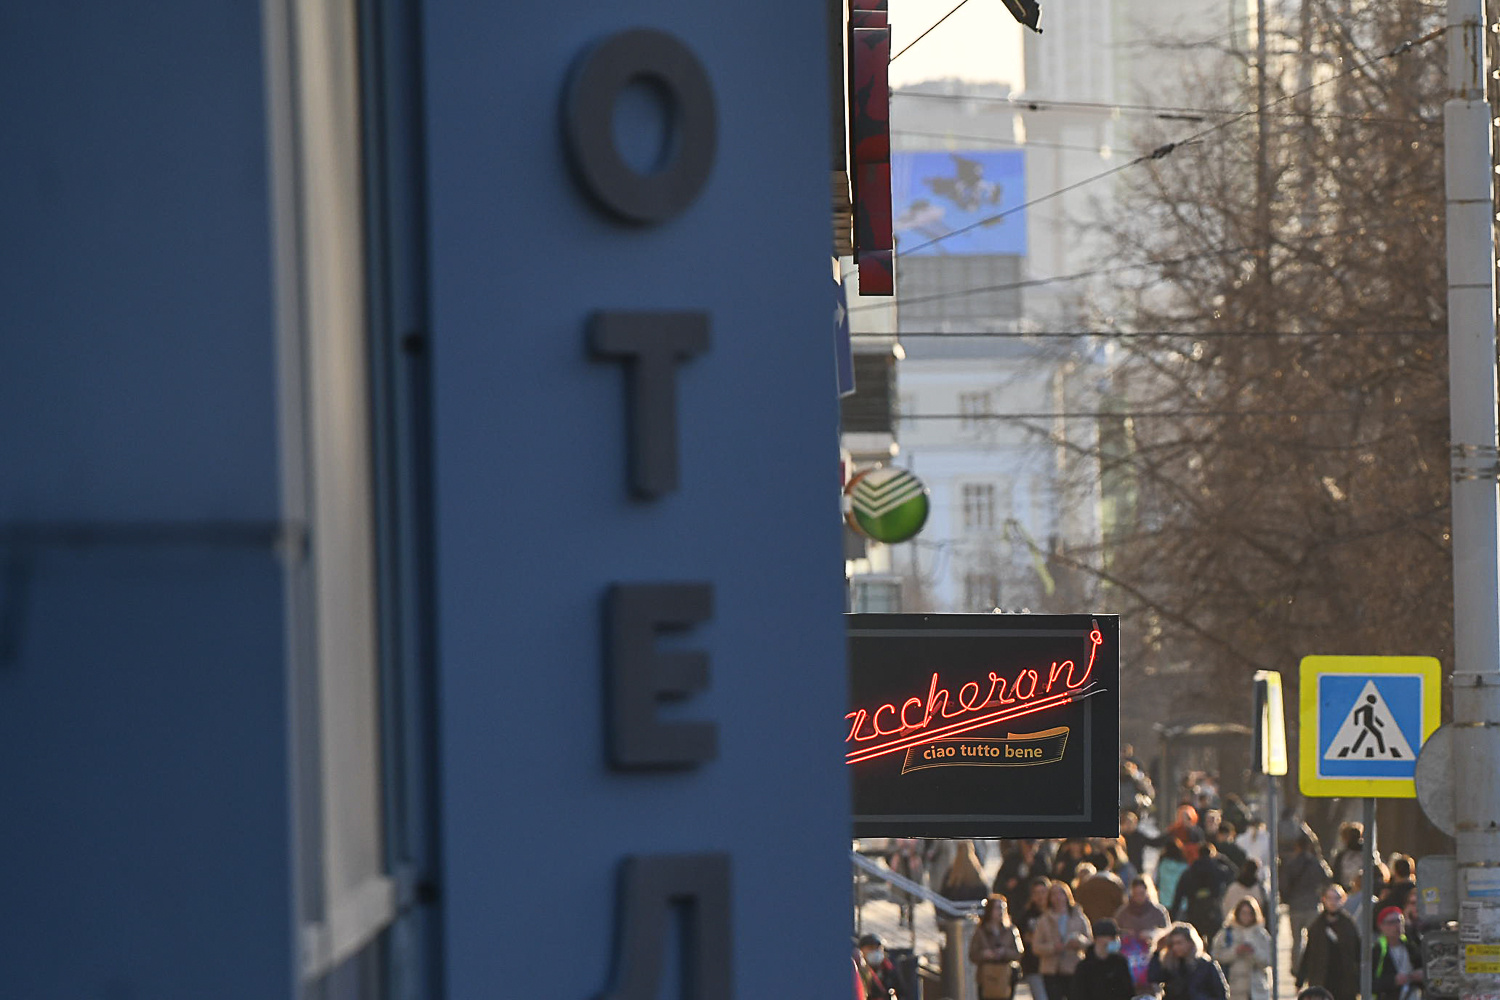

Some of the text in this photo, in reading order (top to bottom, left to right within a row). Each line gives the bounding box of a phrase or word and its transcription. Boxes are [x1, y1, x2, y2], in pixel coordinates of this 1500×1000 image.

[923, 744, 1043, 760] ciao tutto bene
